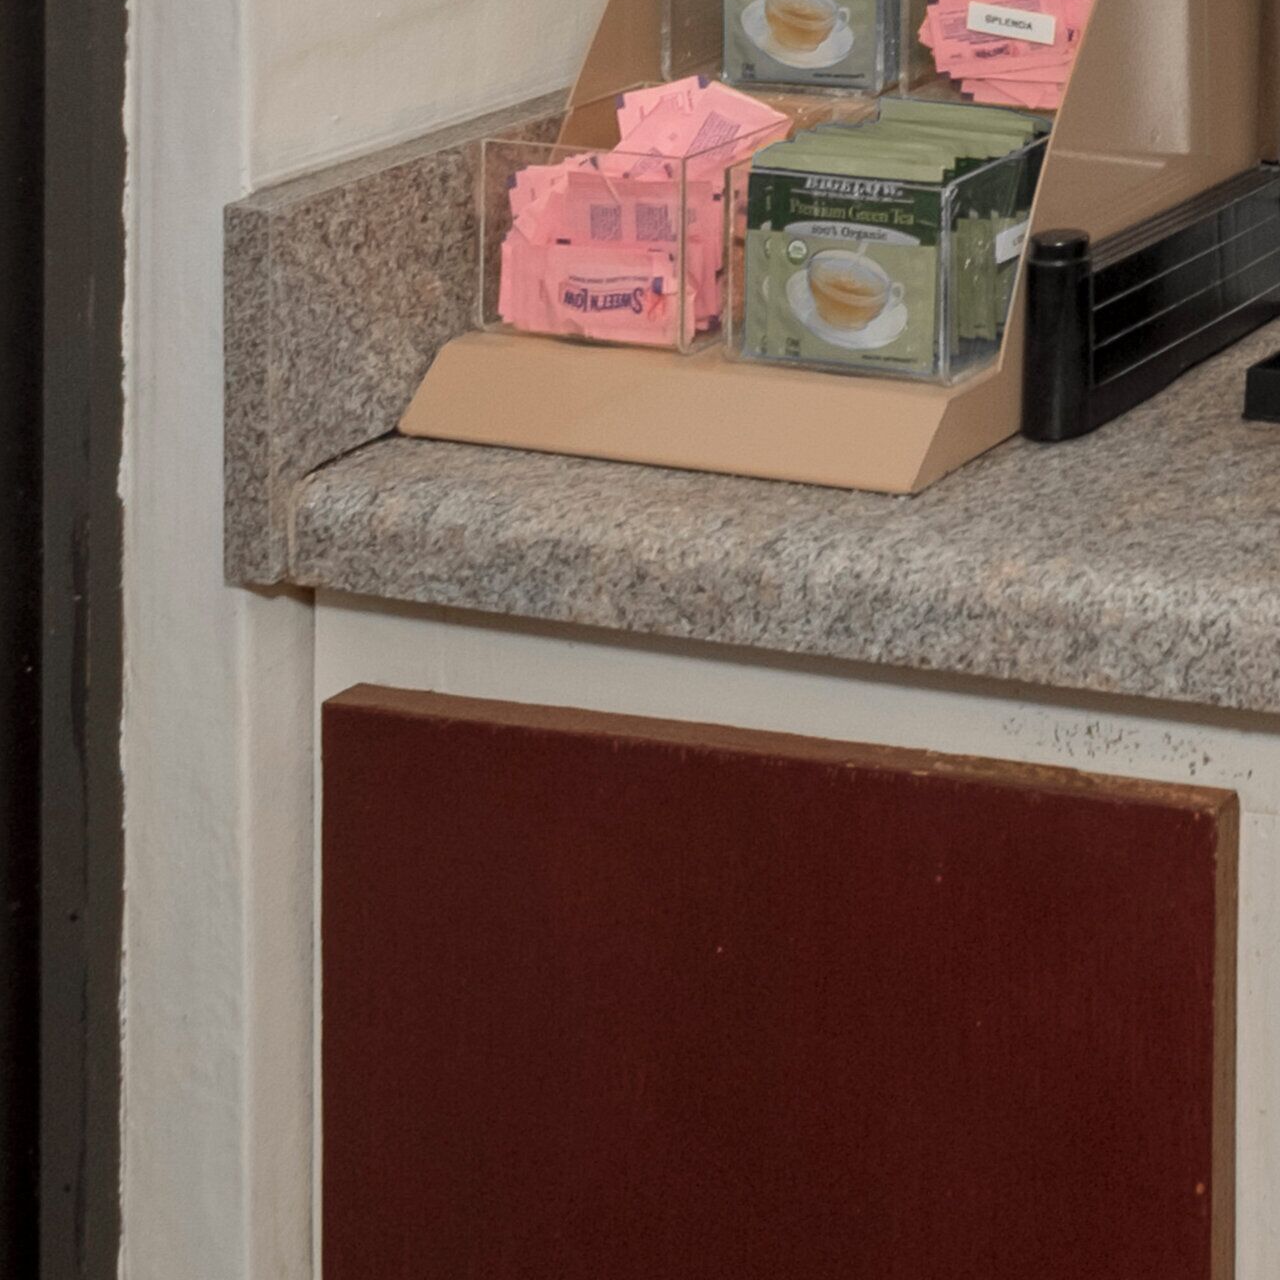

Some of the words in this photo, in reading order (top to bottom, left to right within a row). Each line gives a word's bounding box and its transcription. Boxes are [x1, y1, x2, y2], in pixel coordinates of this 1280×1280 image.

[985, 14, 1033, 31] SPLENDA
[804, 176, 904, 197] BIGELOW
[790, 197, 846, 219] Premium
[848, 204, 889, 222] Green
[892, 208, 915, 224] Tea
[811, 225, 838, 235] 100%
[841, 225, 888, 240] Organic
